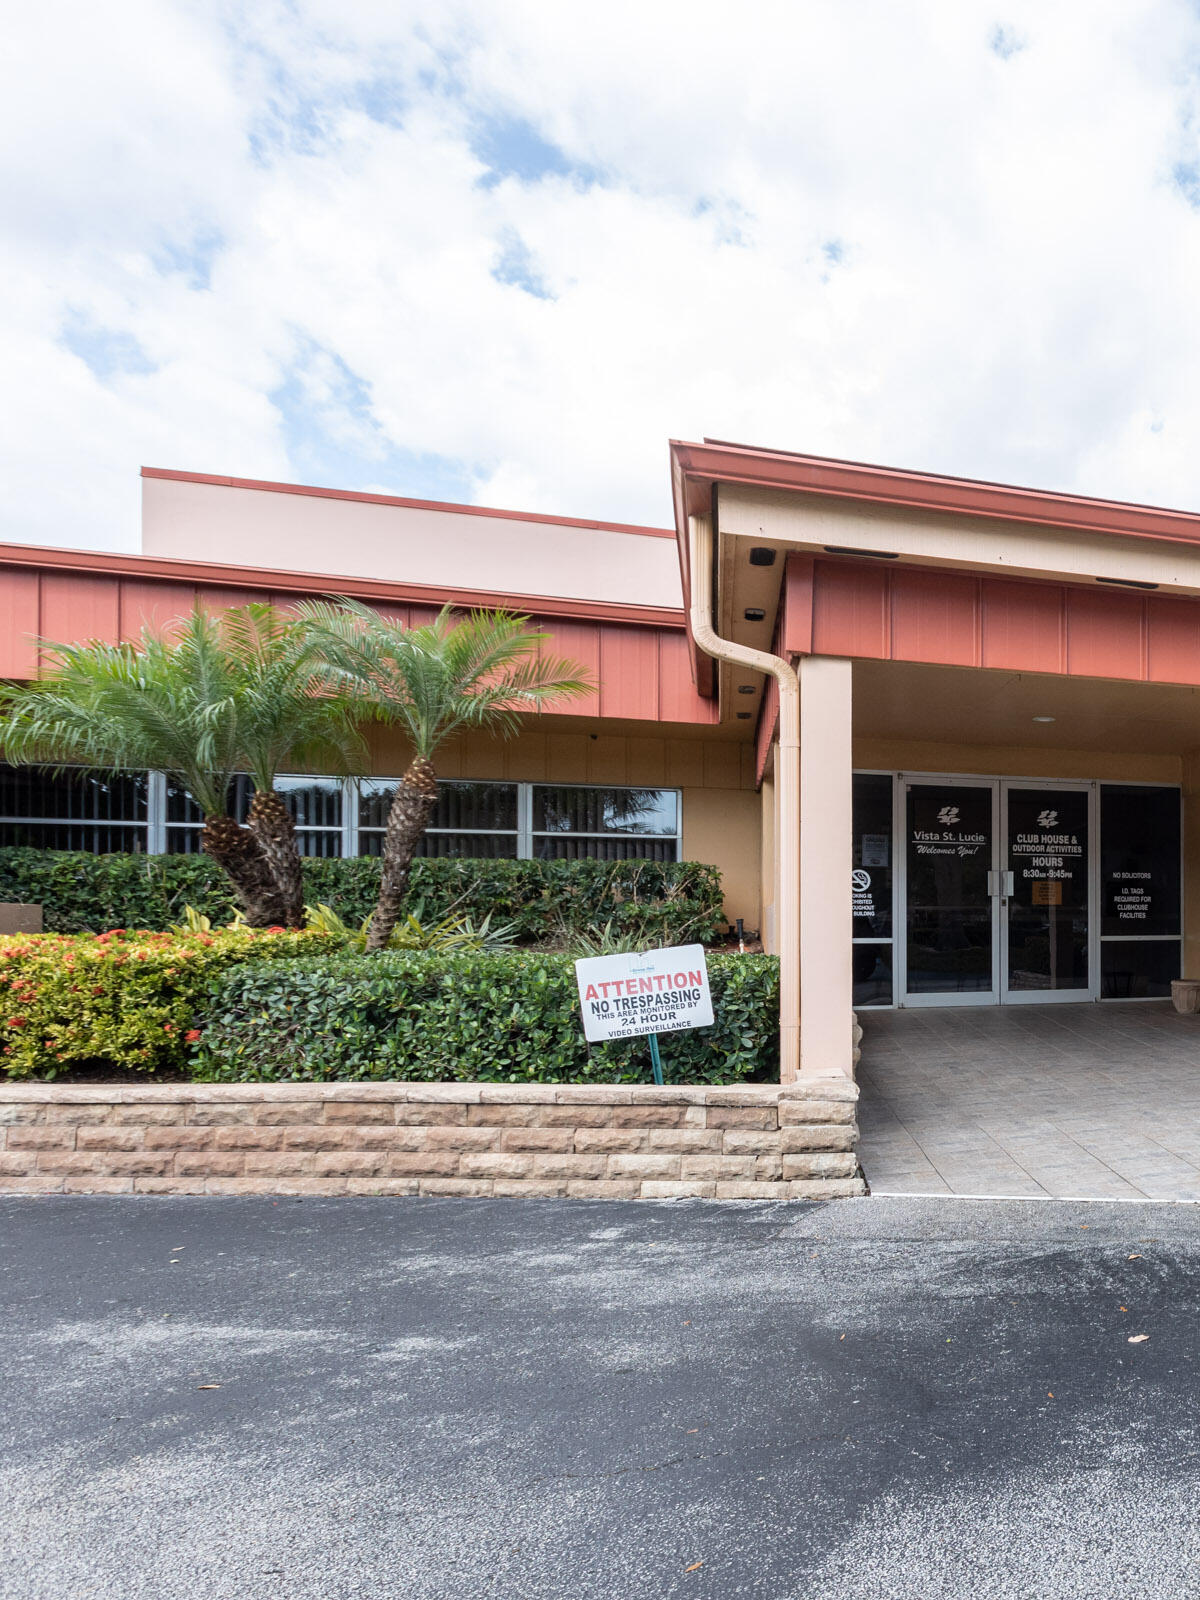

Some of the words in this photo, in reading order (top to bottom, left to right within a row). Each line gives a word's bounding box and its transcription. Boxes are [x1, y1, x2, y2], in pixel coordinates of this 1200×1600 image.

[913, 831, 940, 841] Vista
[942, 832, 956, 841] St.
[959, 832, 985, 841] Lucie
[1016, 834, 1039, 843] CLUB
[1040, 834, 1070, 844] HOUSE
[1071, 835, 1078, 844] &
[916, 845, 956, 854] Welcomes
[957, 844, 979, 858] You!
[1012, 844, 1045, 852] OUTDOOR
[1045, 845, 1082, 853] ACTIVITIES
[1032, 857, 1063, 867] HOURS
[585, 970, 703, 1001] ATTENTION
[591, 1000, 610, 1015] NO
[613, 988, 701, 1011] TRESPASSING
[596, 1010, 615, 1020] THIS
[617, 1008, 638, 1017] AREA
[640, 1003, 686, 1015] MONITORED
[687, 1001, 698, 1009] BY
[621, 1017, 637, 1027] 24
[640, 1011, 678, 1024] HOUR
[608, 1028, 632, 1038] VIDEO
[634, 1020, 692, 1034] SURVEILLANCE
